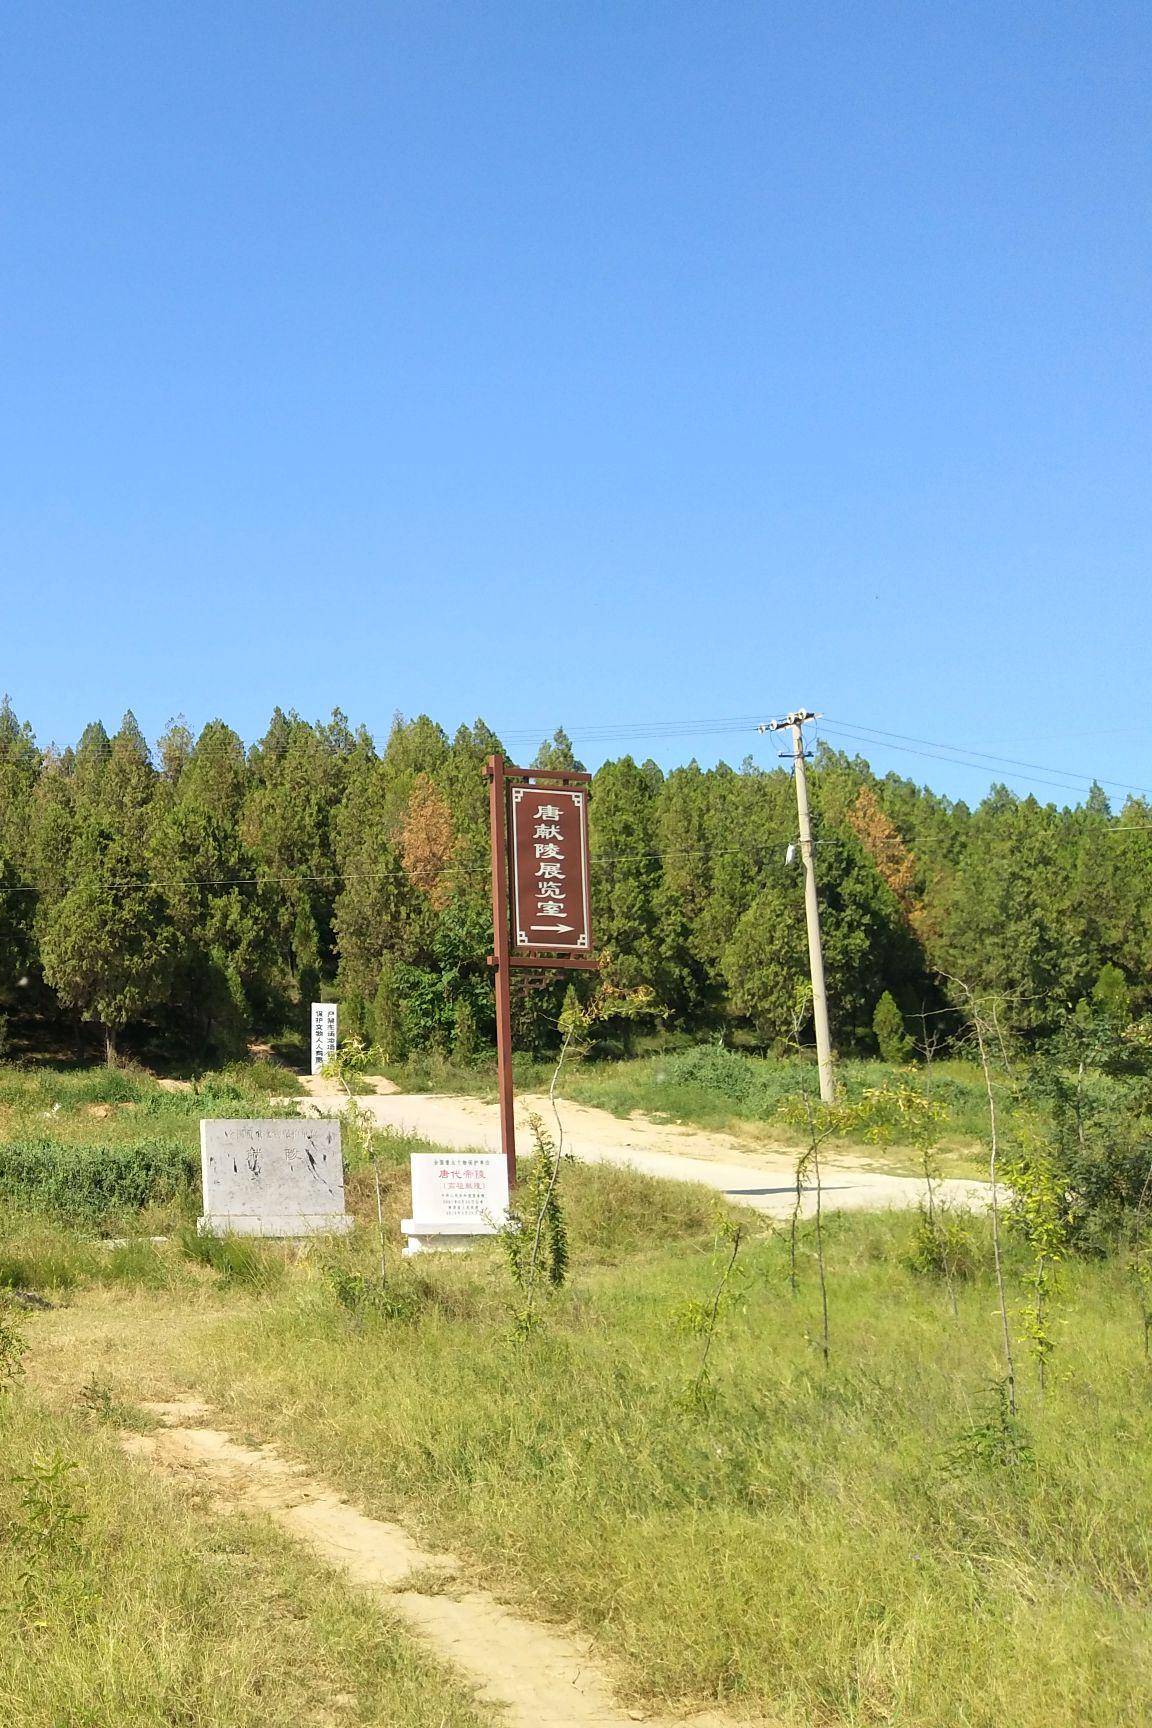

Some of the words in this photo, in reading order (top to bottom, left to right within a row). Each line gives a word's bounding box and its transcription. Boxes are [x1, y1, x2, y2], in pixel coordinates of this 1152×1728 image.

[532, 804, 567, 918] 唐献陵展览室
[438, 1169, 487, 1179] 唐代帝陵
